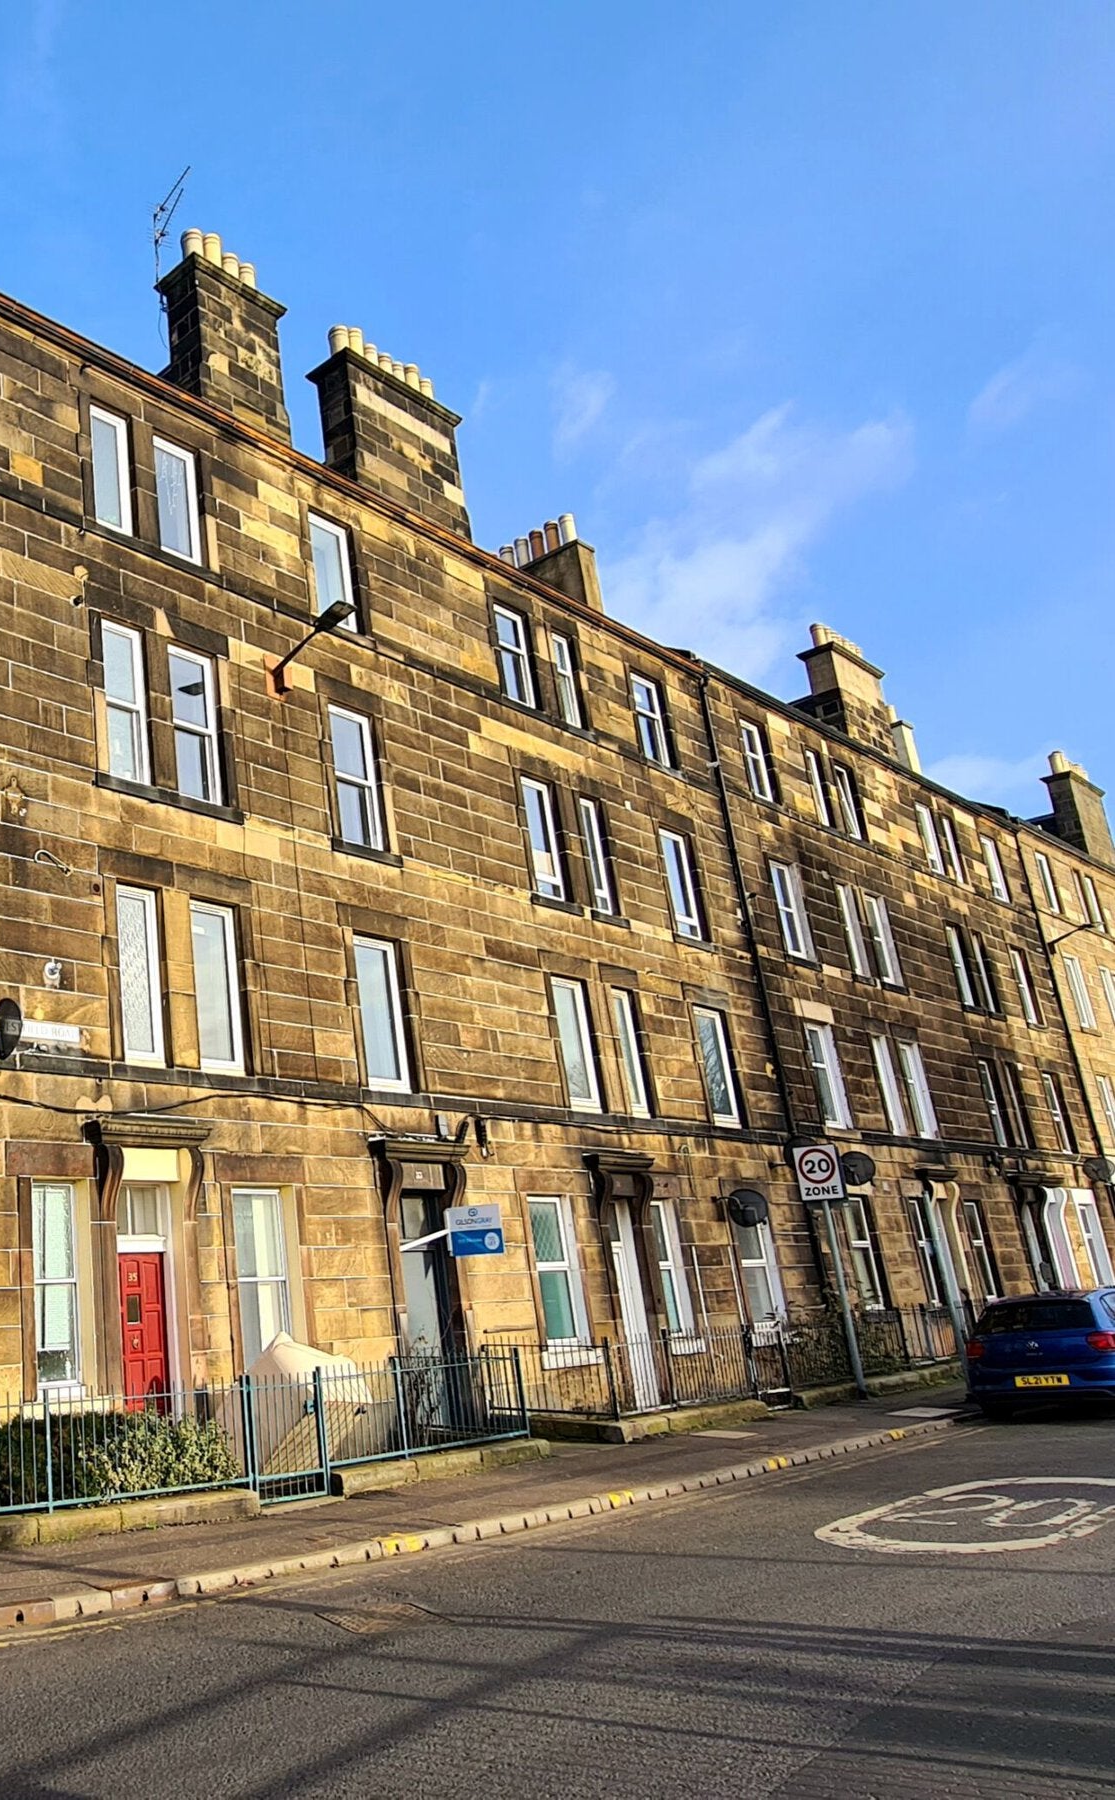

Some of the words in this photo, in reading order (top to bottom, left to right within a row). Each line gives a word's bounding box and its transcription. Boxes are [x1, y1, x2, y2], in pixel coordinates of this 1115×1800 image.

[804, 1158, 831, 1174] 20
[804, 1185, 839, 1197] ZONE
[127, 1272, 138, 1282] 35
[1020, 1376, 1042, 1385] SL21
[880, 1494, 1097, 1527] 20
